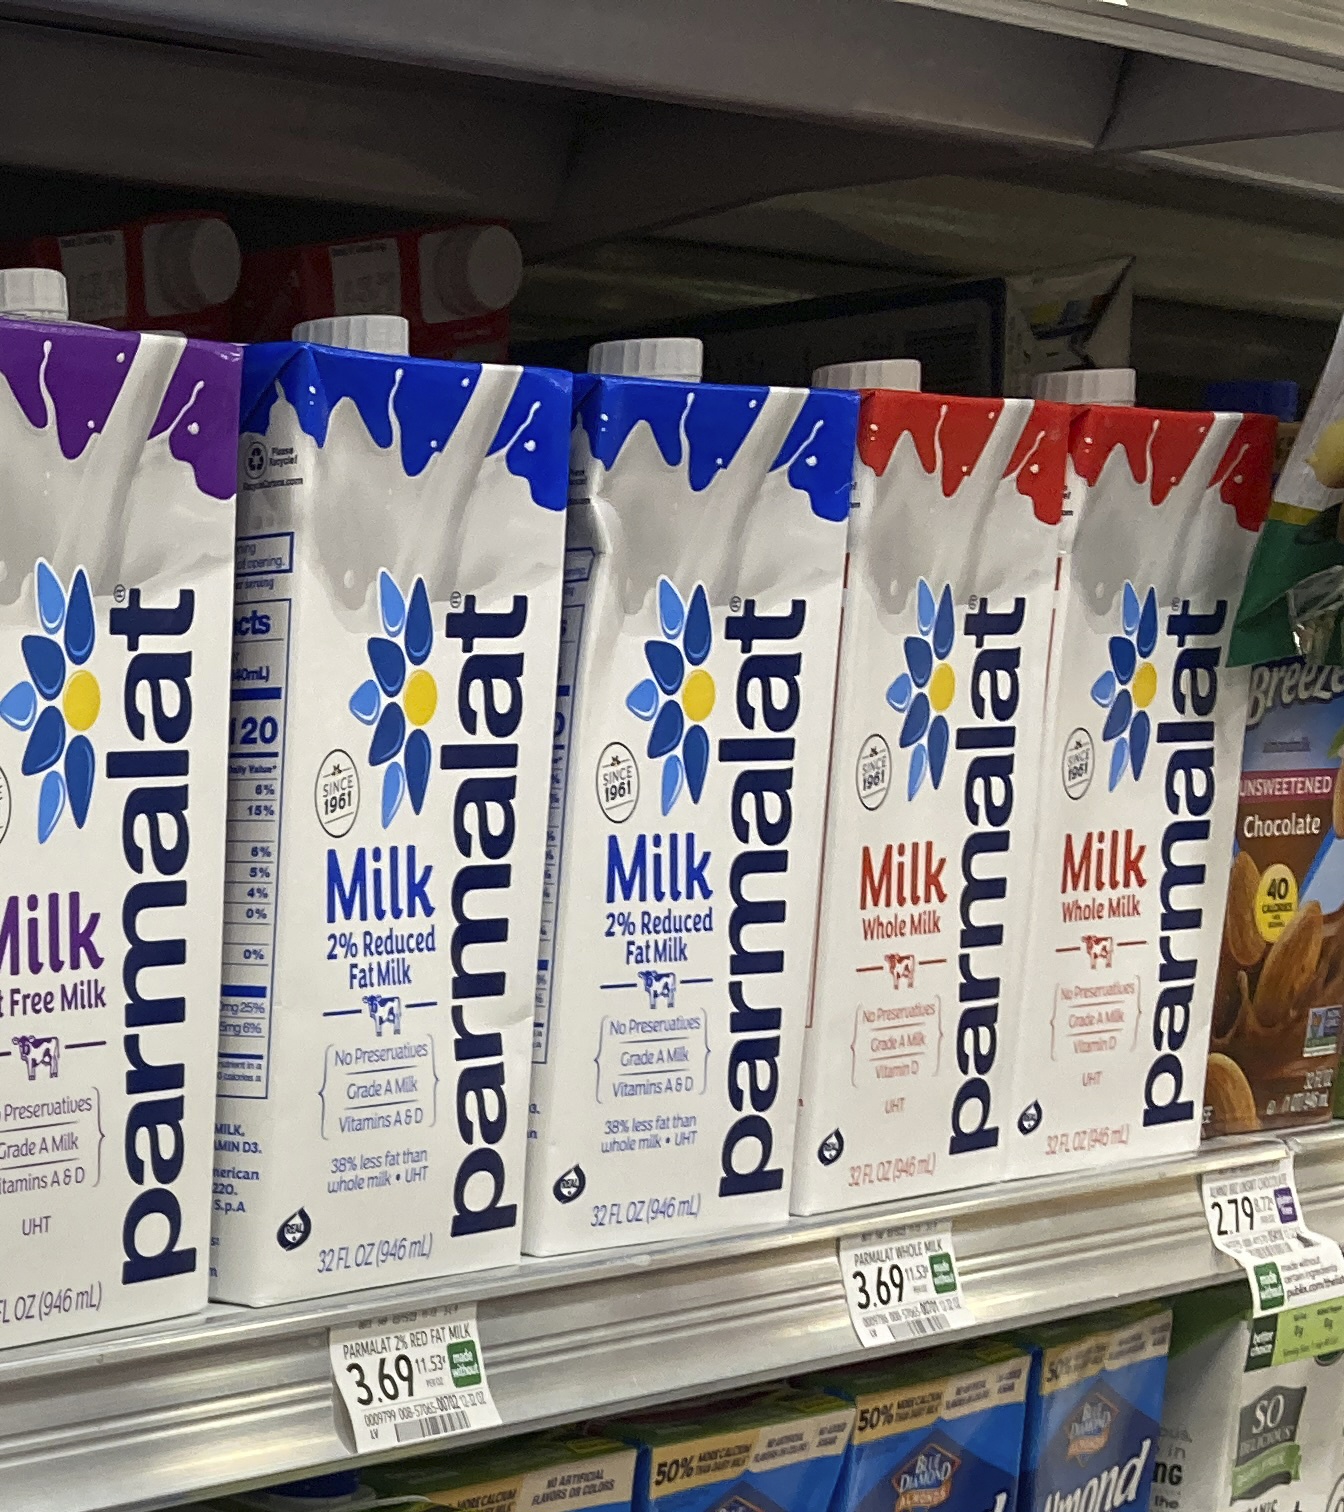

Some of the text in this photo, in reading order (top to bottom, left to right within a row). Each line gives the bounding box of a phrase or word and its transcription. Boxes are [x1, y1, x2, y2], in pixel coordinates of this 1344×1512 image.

[1244, 815, 1321, 837] Chocolate
[949, 596, 1026, 1155] parmalat
[1060, 828, 1147, 894] Milk
[1142, 599, 1228, 1127] parmalat
[327, 844, 435, 924] Milk
[718, 599, 806, 1198] parmalat
[106, 588, 197, 1285] parmalat
[440, 594, 529, 1238] parmalat
[862, 910, 941, 940] Whole Milk
[327, 926, 436, 960] 2% Reduced
[348, 958, 411, 990] Fat Milk
[1211, 1196, 1255, 1236] 2.79
[852, 1264, 904, 1309] 3.69
[343, 1323, 471, 1360] PARMALAT 2% RED FAT MILK
[346, 1354, 414, 1406] 3.69
[1251, 1394, 1284, 1428] SO
[654, 1456, 694, 1486] 50%
